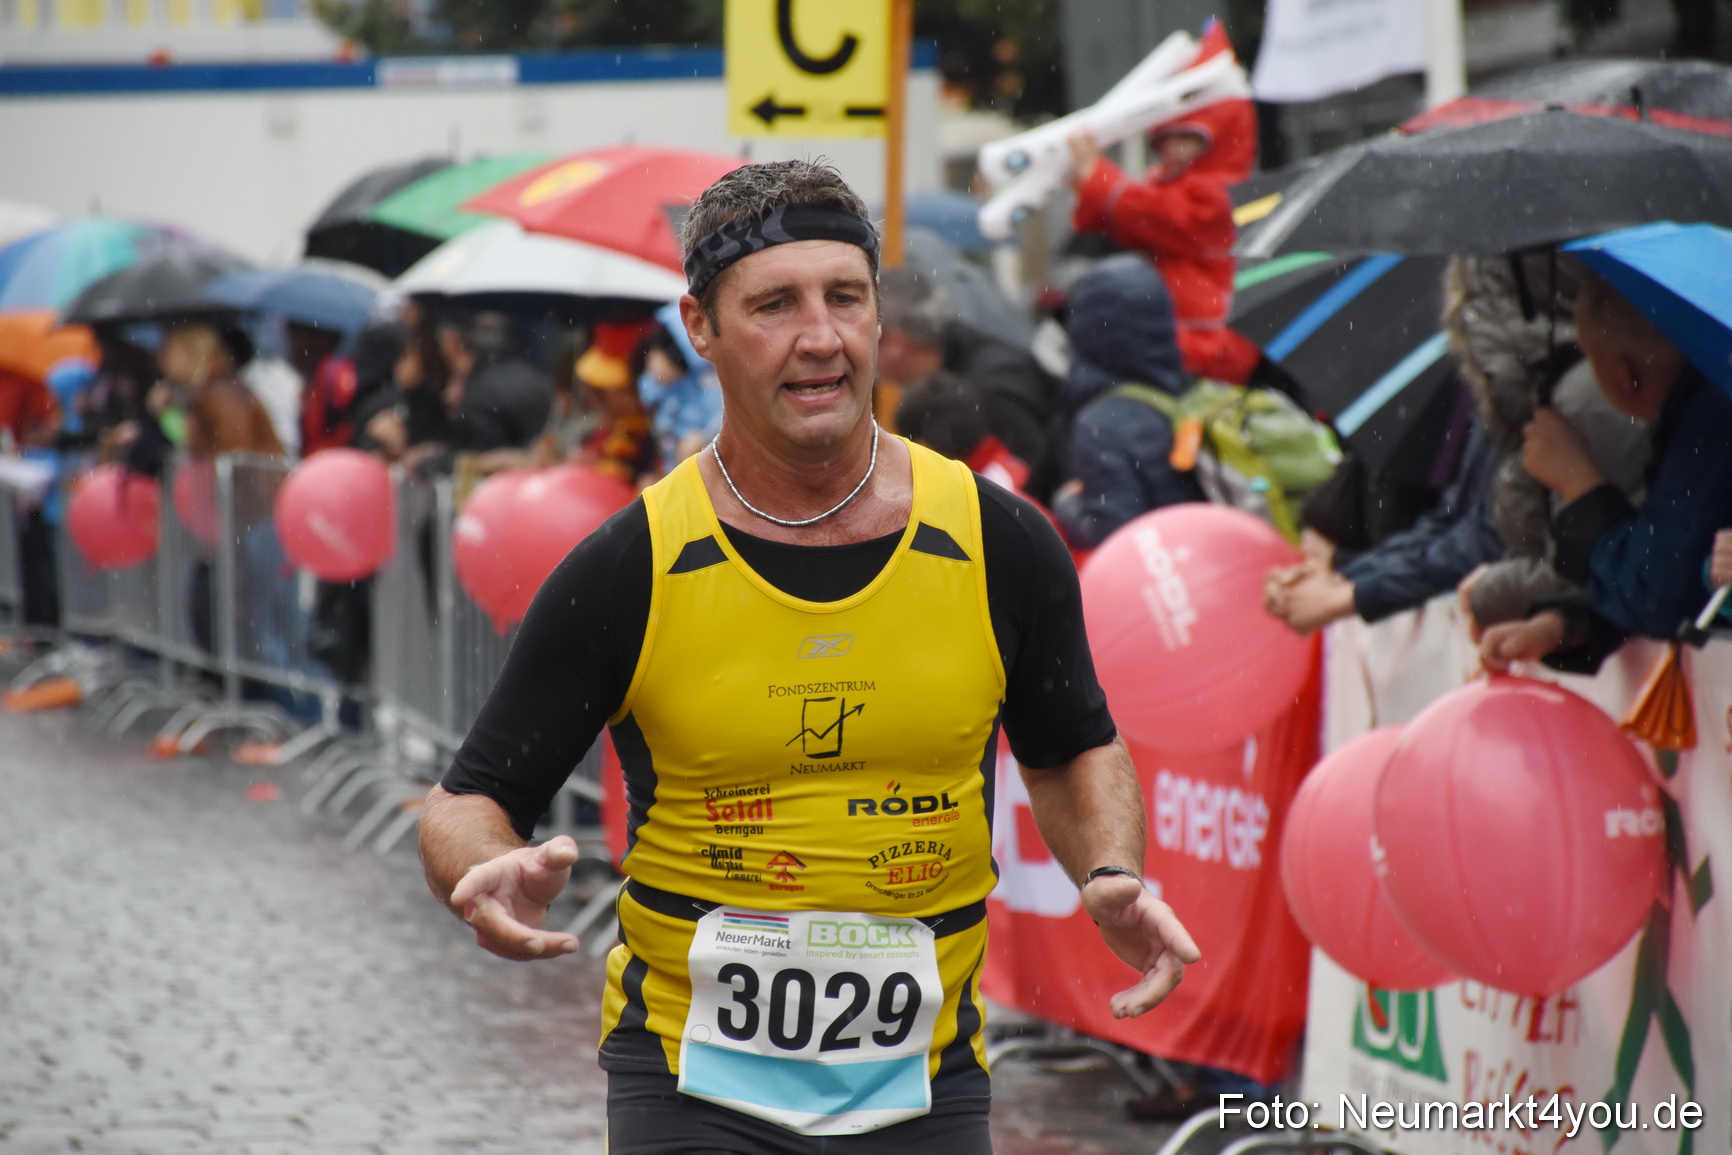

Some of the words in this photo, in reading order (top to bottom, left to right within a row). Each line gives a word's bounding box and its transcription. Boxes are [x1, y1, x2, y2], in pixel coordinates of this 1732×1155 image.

[768, 681, 876, 698] FONDSZENTRUM
[790, 761, 867, 775] NEUMARKT
[703, 783, 771, 799] Schreinerei
[705, 798, 773, 822] Seidl
[714, 824, 764, 837] Berngau
[868, 841, 952, 869] PIZZERIA
[886, 861, 944, 885] ELIO
[715, 931, 792, 950] NeuerMarkt
[808, 921, 916, 948] BOCK
[806, 949, 844, 959] inspired
[845, 950, 857, 960] by
[859, 950, 884, 959] smart
[886, 951, 920, 960] concepts
[717, 962, 922, 1053] 3029
